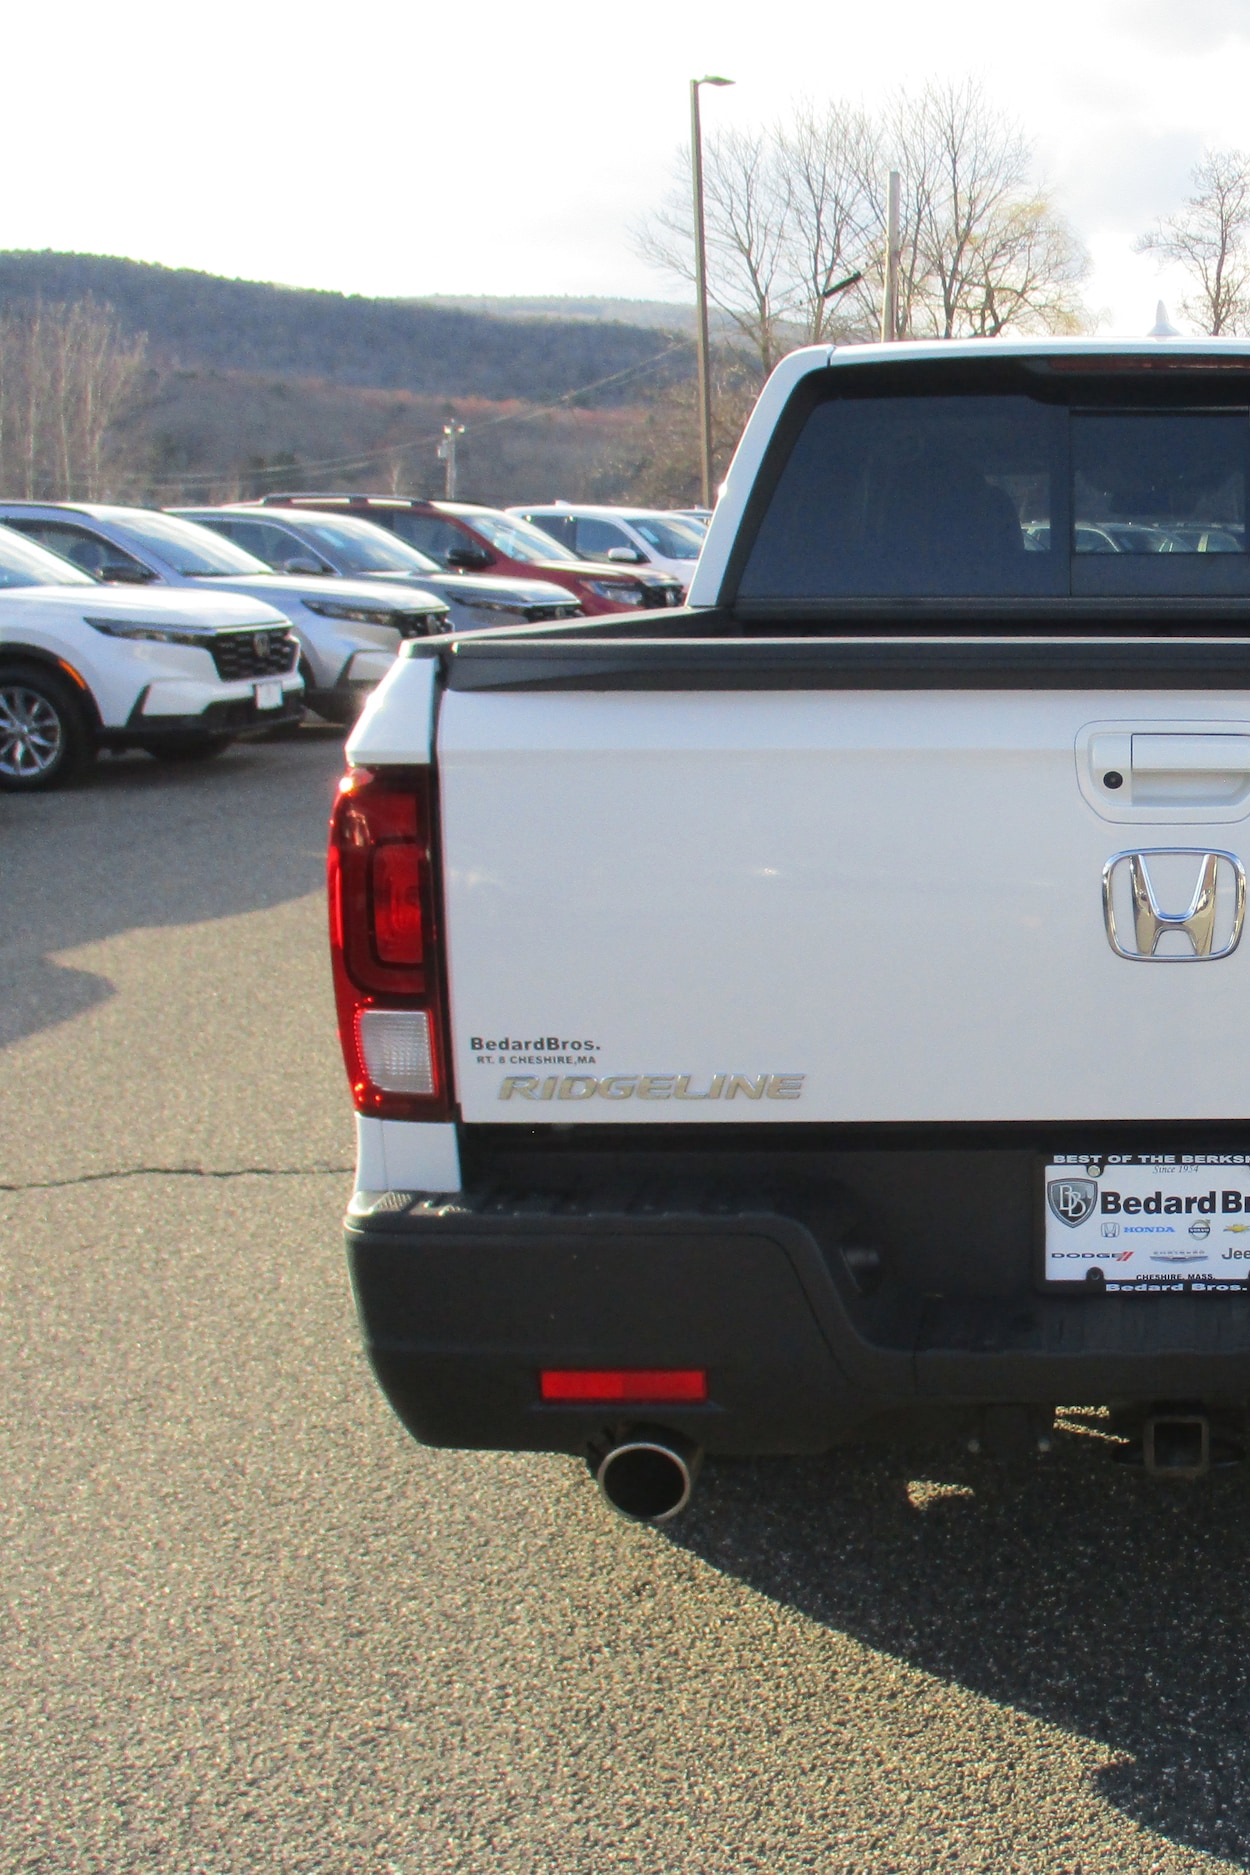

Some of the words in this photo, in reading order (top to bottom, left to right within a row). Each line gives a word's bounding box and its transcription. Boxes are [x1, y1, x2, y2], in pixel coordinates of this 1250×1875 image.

[470, 1037, 601, 1051] BedardBros.
[476, 1056, 495, 1064] RT.
[498, 1073, 805, 1101] RIDGELINE
[1053, 1155, 1102, 1163] BEST
[1108, 1155, 1132, 1163] OF
[1138, 1155, 1176, 1163] THE
[1152, 1165, 1176, 1174] Since
[1101, 1191, 1216, 1214] Bedard
[1105, 1283, 1184, 1291] Bedard
[1191, 1283, 1248, 1291] Bros.
